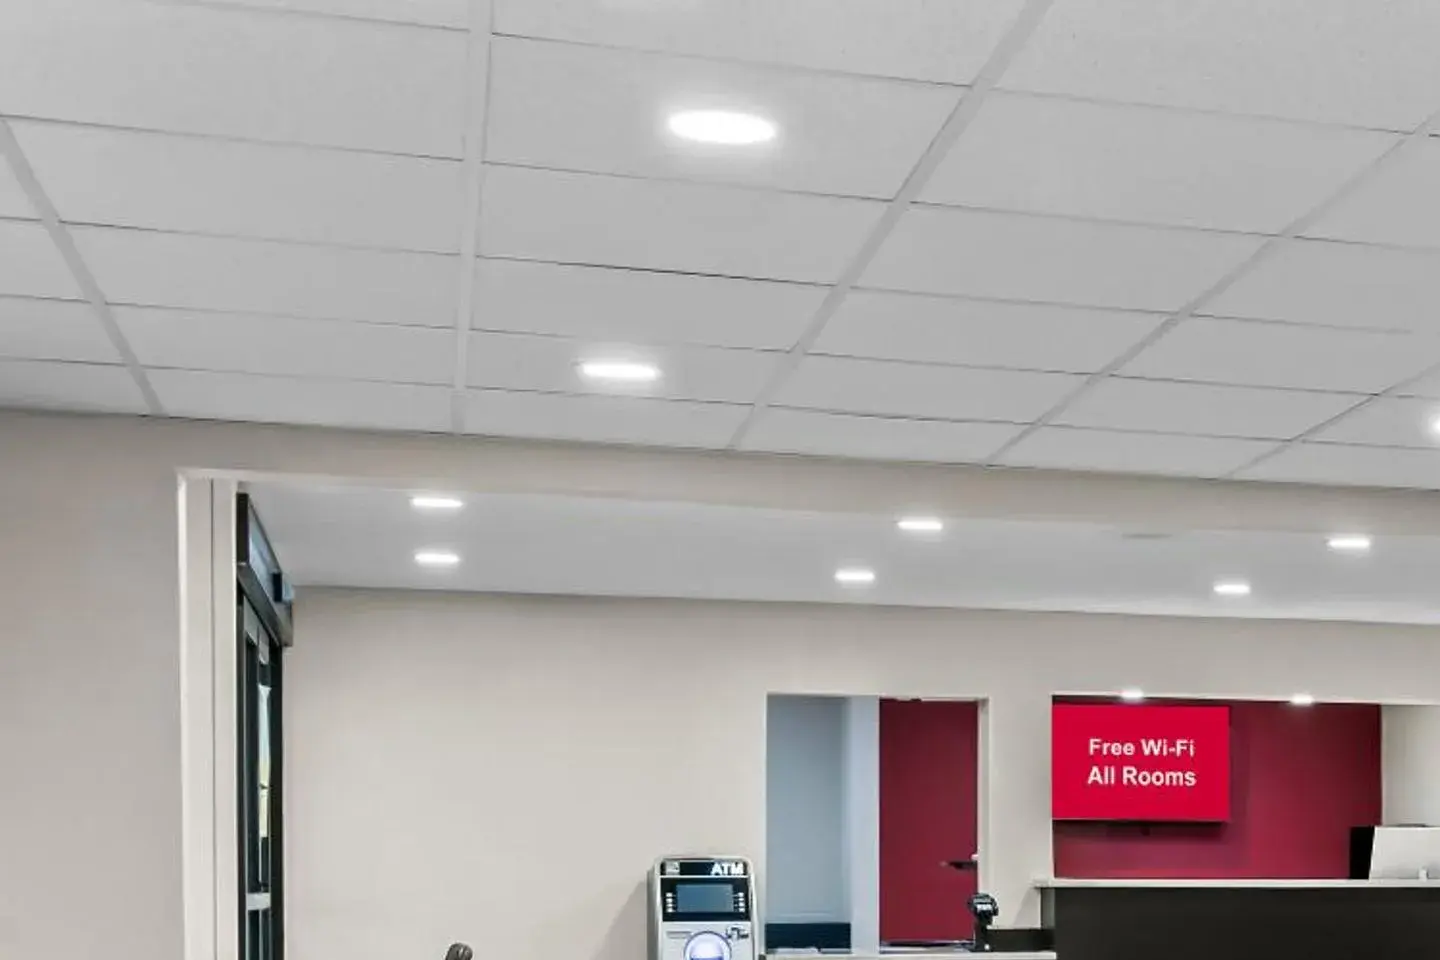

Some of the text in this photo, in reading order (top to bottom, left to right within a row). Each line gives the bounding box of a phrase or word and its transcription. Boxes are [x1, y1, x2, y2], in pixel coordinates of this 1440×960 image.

[1088, 738, 1196, 757] Free Wi-Fi
[1087, 765, 1197, 787] All Rooms
[710, 862, 744, 876] ATM
